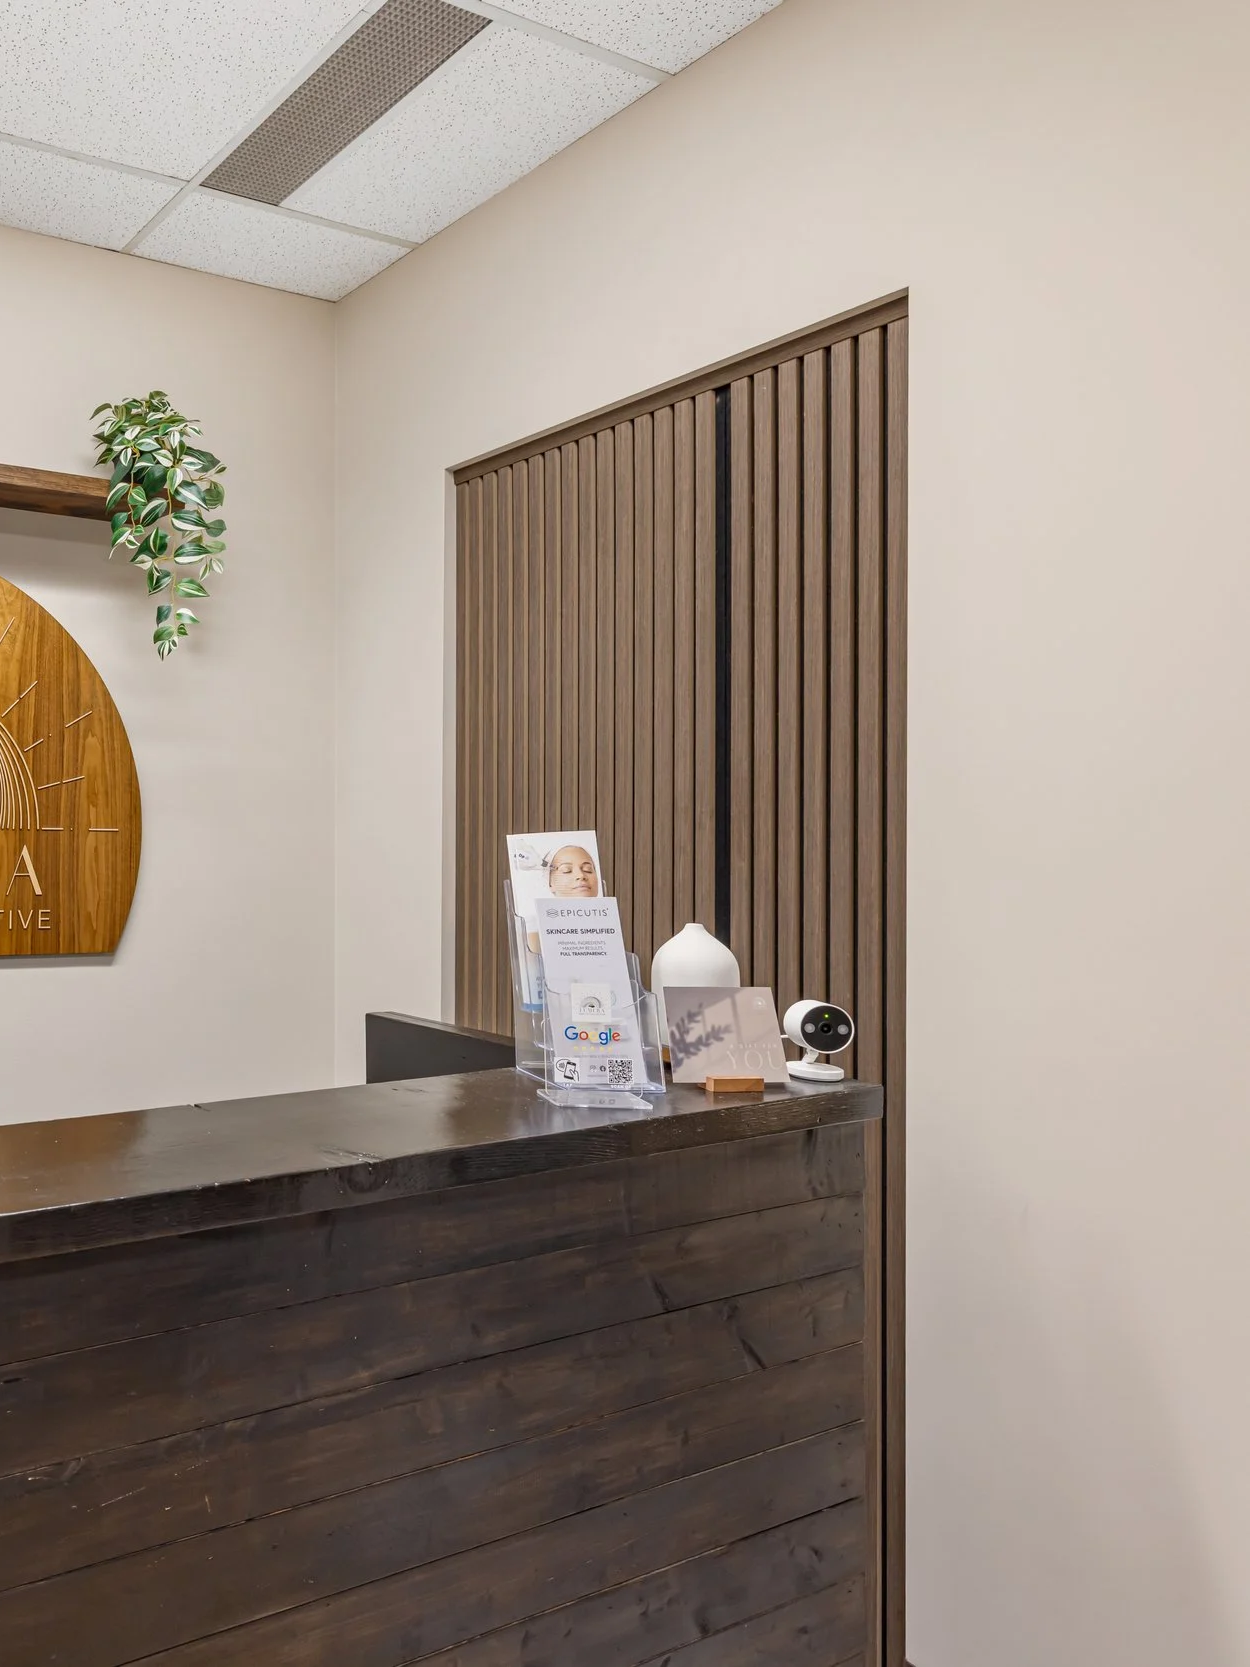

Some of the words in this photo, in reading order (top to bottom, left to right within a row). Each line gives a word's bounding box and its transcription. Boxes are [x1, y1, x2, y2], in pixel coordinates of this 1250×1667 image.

[560, 909, 608, 917] EPICUTIS
[564, 1026, 620, 1045] Google
[727, 1049, 783, 1070] YOU
